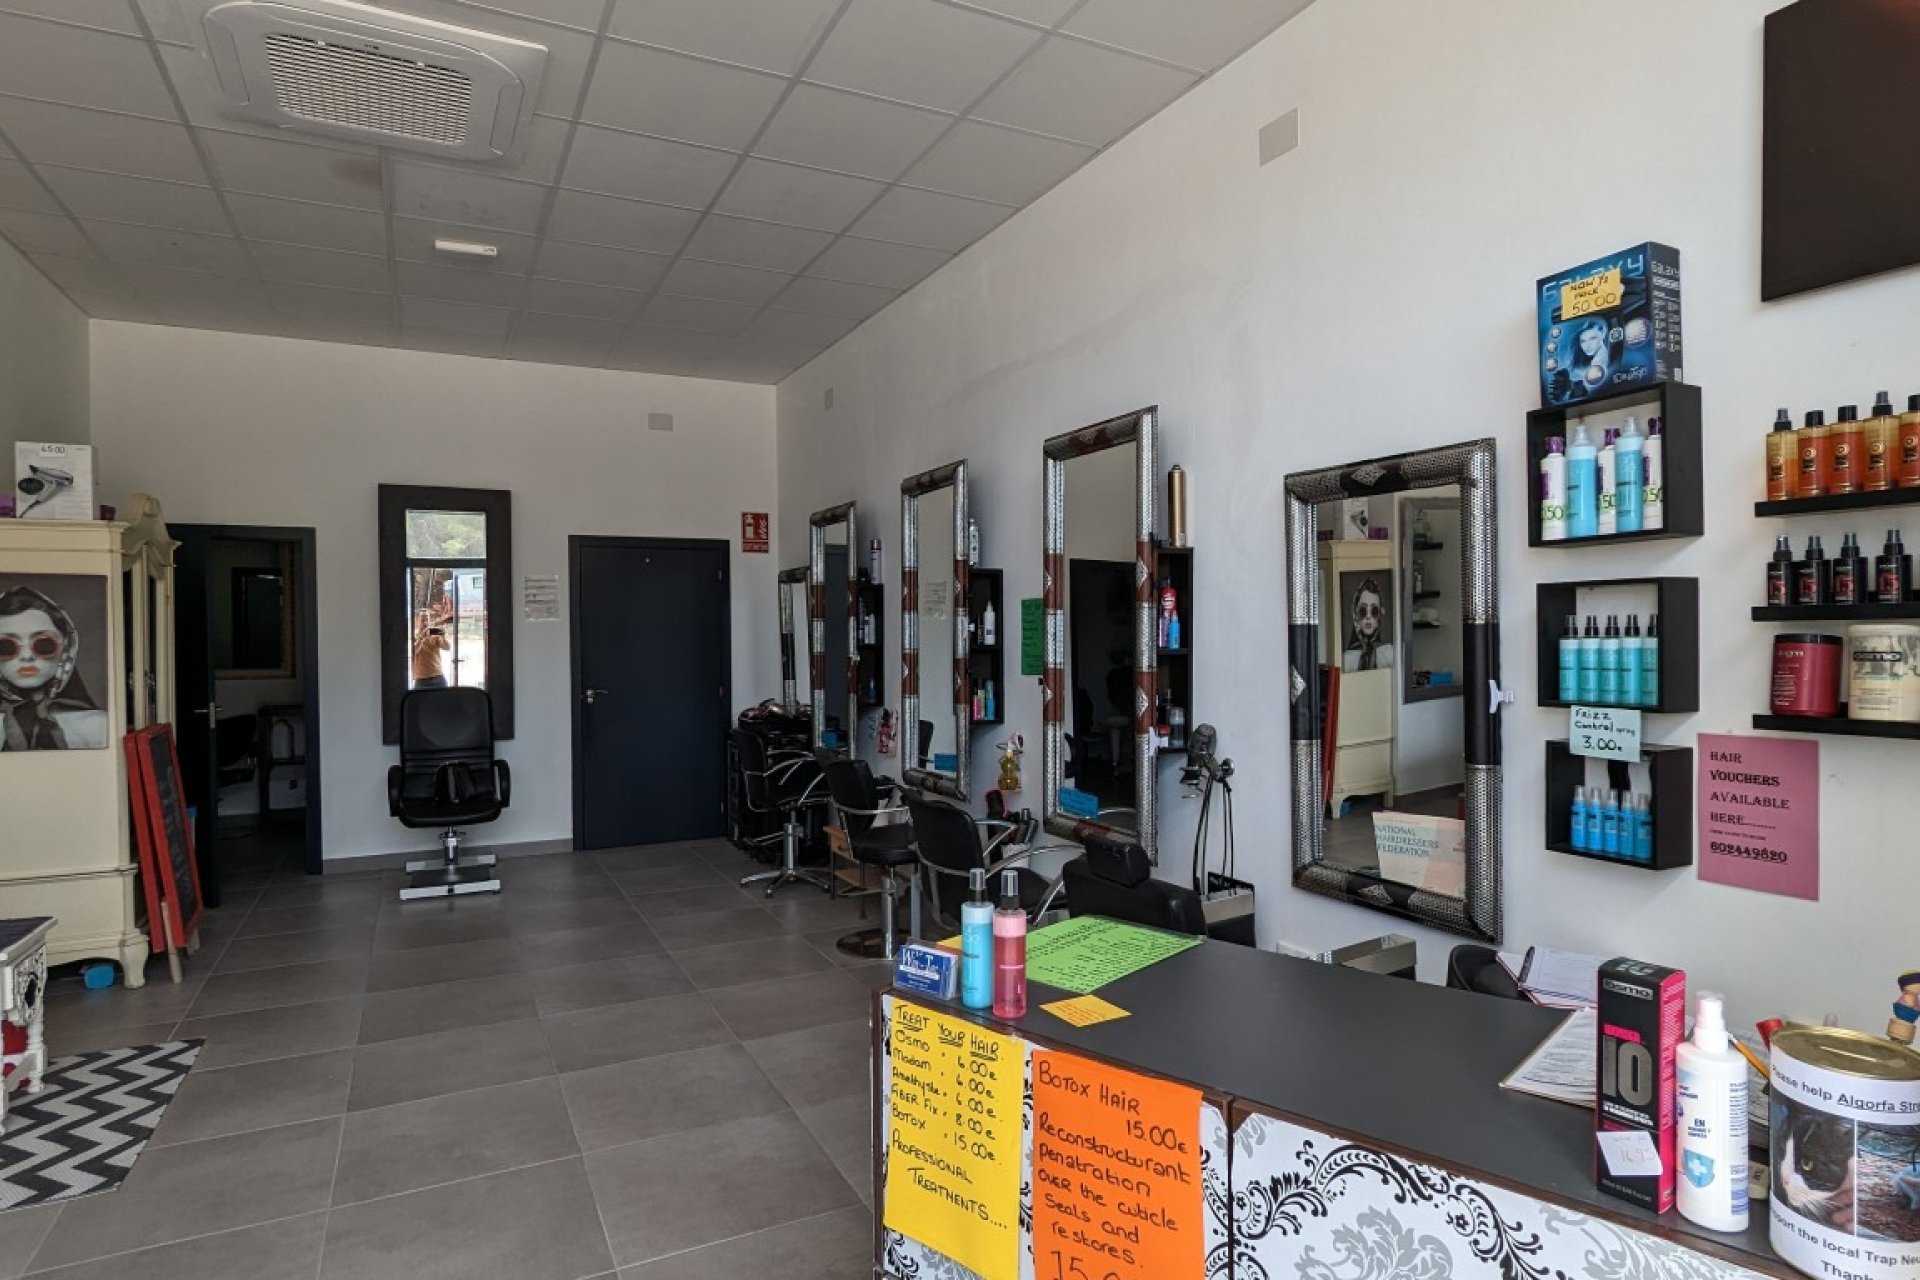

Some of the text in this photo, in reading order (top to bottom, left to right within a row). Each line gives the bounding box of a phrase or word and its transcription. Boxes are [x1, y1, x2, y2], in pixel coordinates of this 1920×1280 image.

[1710, 751, 1743, 763] HAIR
[1709, 769, 1781, 787] VOUCHERS
[1710, 791, 1790, 809] AVAILABLE
[1375, 824, 1416, 836] NATIONAL
[1376, 834, 1439, 849] HAIRDRESSERS
[1377, 843, 1429, 857] FEDERATION
[895, 1004, 999, 1054] TREAT YOUR HAIR
[895, 1029, 930, 1052] Osmo
[892, 1047, 931, 1071] Madam
[1602, 1035, 1652, 1106] 10
[1039, 1060, 1090, 1097] BOTOX
[1802, 1082, 1833, 1101] help
[1837, 1093, 1895, 1113] Algorfa
[893, 1103, 926, 1129] BOTOX
[893, 1128, 973, 1184] PROFESSIONAL
[1080, 1182, 1107, 1207] the
[1045, 1193, 1139, 1245] Seals and
[1798, 1227, 1819, 1244] the
[1822, 1238, 1860, 1259] local
[1865, 1250, 1897, 1267] Trap
